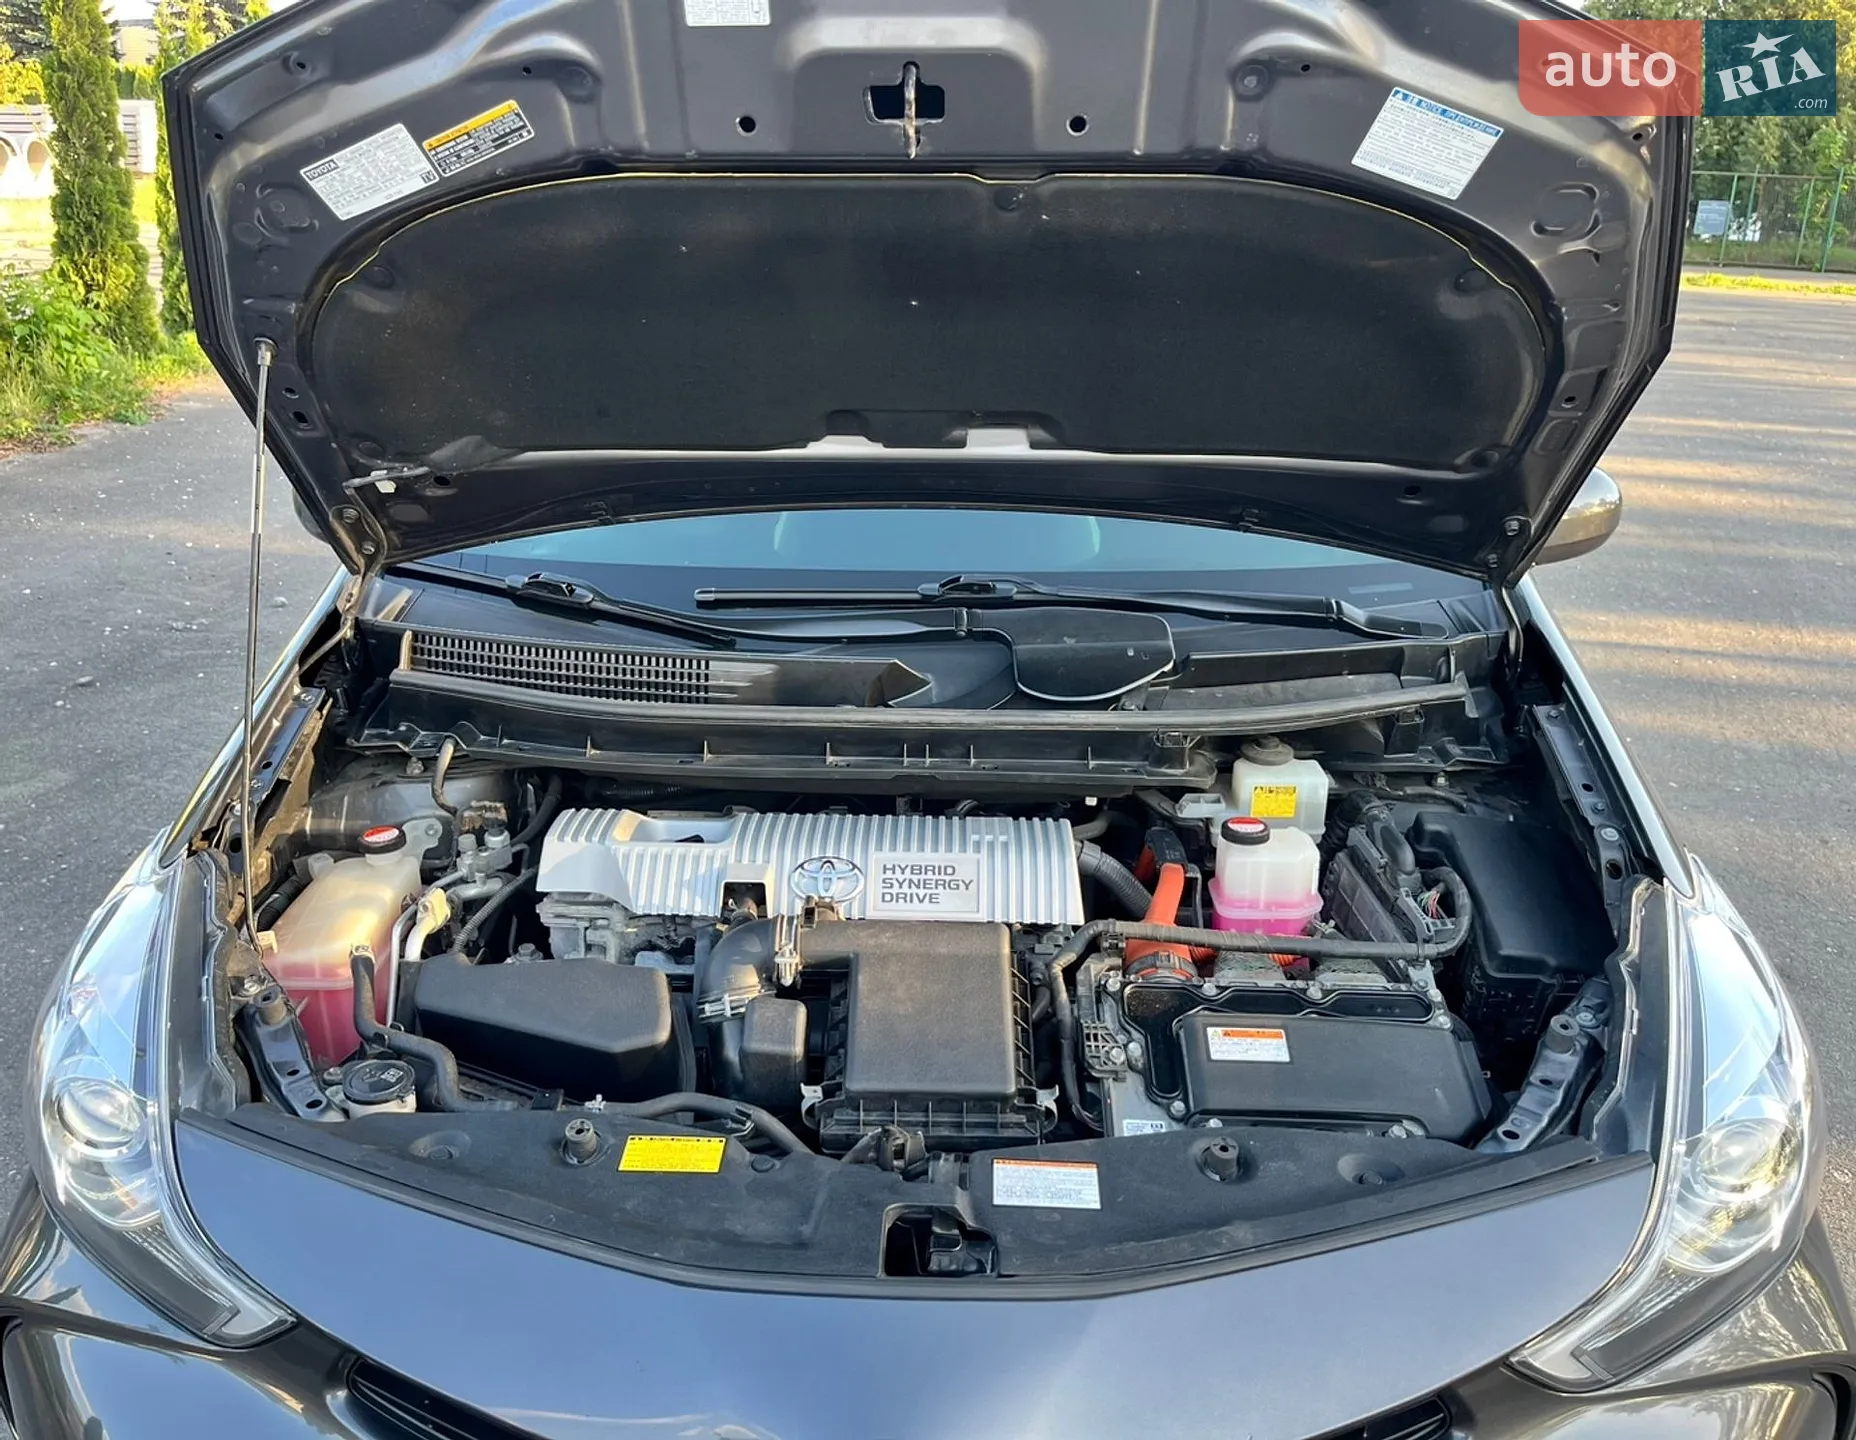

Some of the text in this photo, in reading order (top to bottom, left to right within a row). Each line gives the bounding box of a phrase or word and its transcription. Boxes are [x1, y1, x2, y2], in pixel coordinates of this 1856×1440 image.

[305, 161, 338, 179] TOYOTA
[421, 171, 436, 183] TV
[882, 864, 956, 876] HYBRID
[881, 878, 974, 891] SYNERGY
[881, 892, 941, 904] DRIVE
